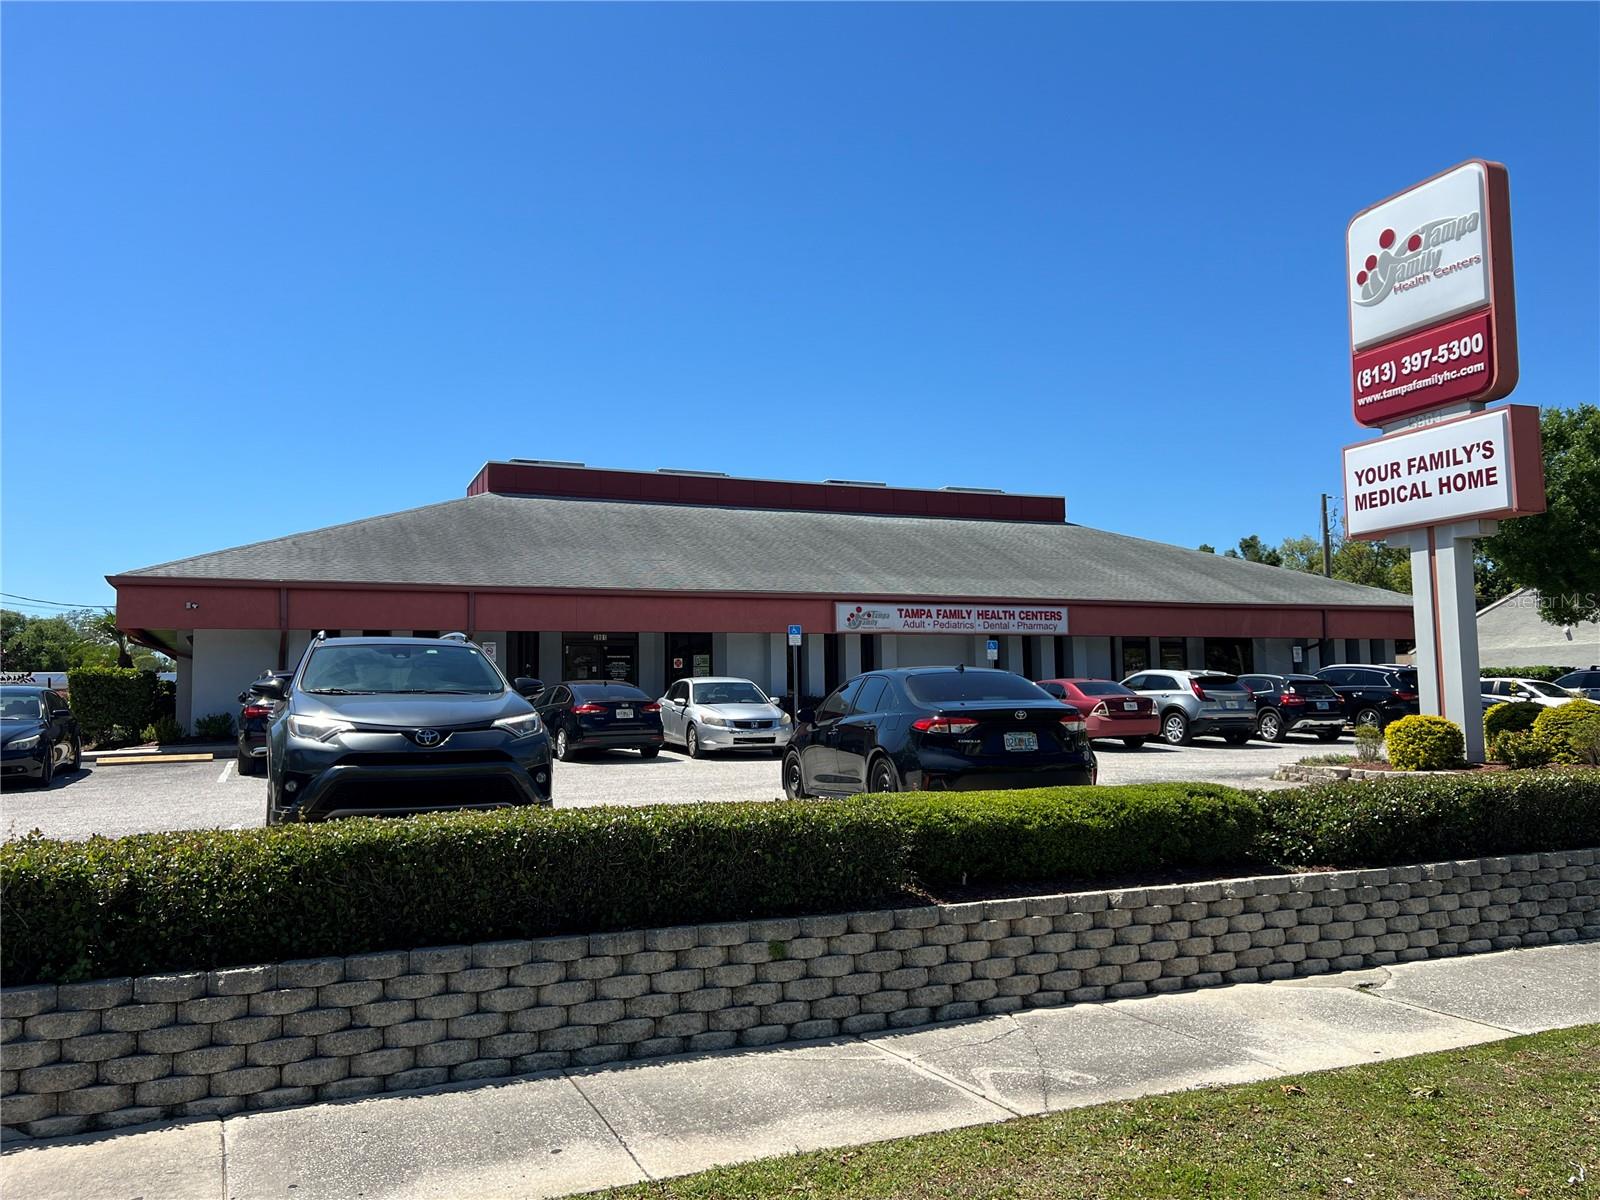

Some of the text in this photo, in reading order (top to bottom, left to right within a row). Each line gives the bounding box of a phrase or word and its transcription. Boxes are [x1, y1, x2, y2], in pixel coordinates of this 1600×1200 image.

[1421, 211, 1479, 250] Tampa
[1392, 254, 1482, 296] Health Centers
[1356, 333, 1485, 392] (813) 397-5300
[1357, 360, 1485, 407] www.tampafamilyhc.com
[1354, 440, 1495, 487] YOUR FAMILY'S
[1355, 466, 1498, 512] MEDICAL HOME
[897, 608, 1063, 622] TAMPA FAMILY HEALTH CENTERS
[902, 619, 1058, 632] Adult Pediatrics Dental Pharmacy
